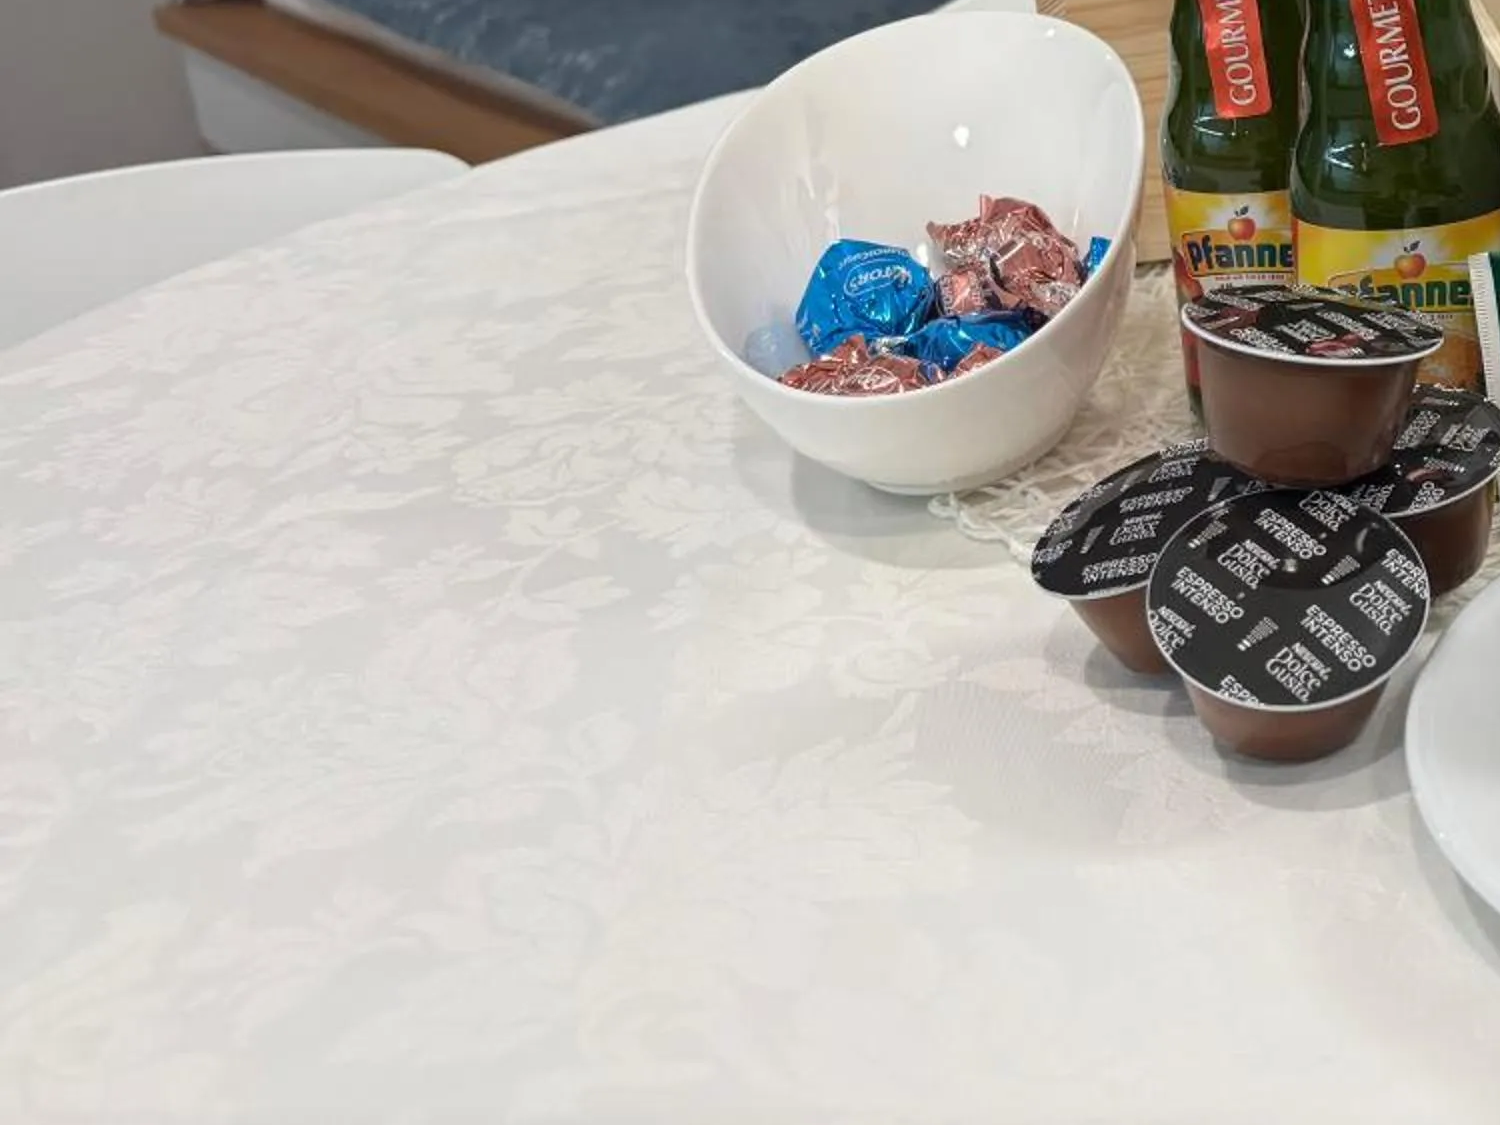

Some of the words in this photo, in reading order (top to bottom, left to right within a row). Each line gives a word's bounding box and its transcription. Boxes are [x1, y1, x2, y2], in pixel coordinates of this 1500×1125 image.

[1170, 577, 1230, 624] INTENSO
[1176, 566, 1245, 620] ESPRESSO
[1300, 615, 1362, 672] INTENSO
[1306, 604, 1377, 668] ESPRESSO
